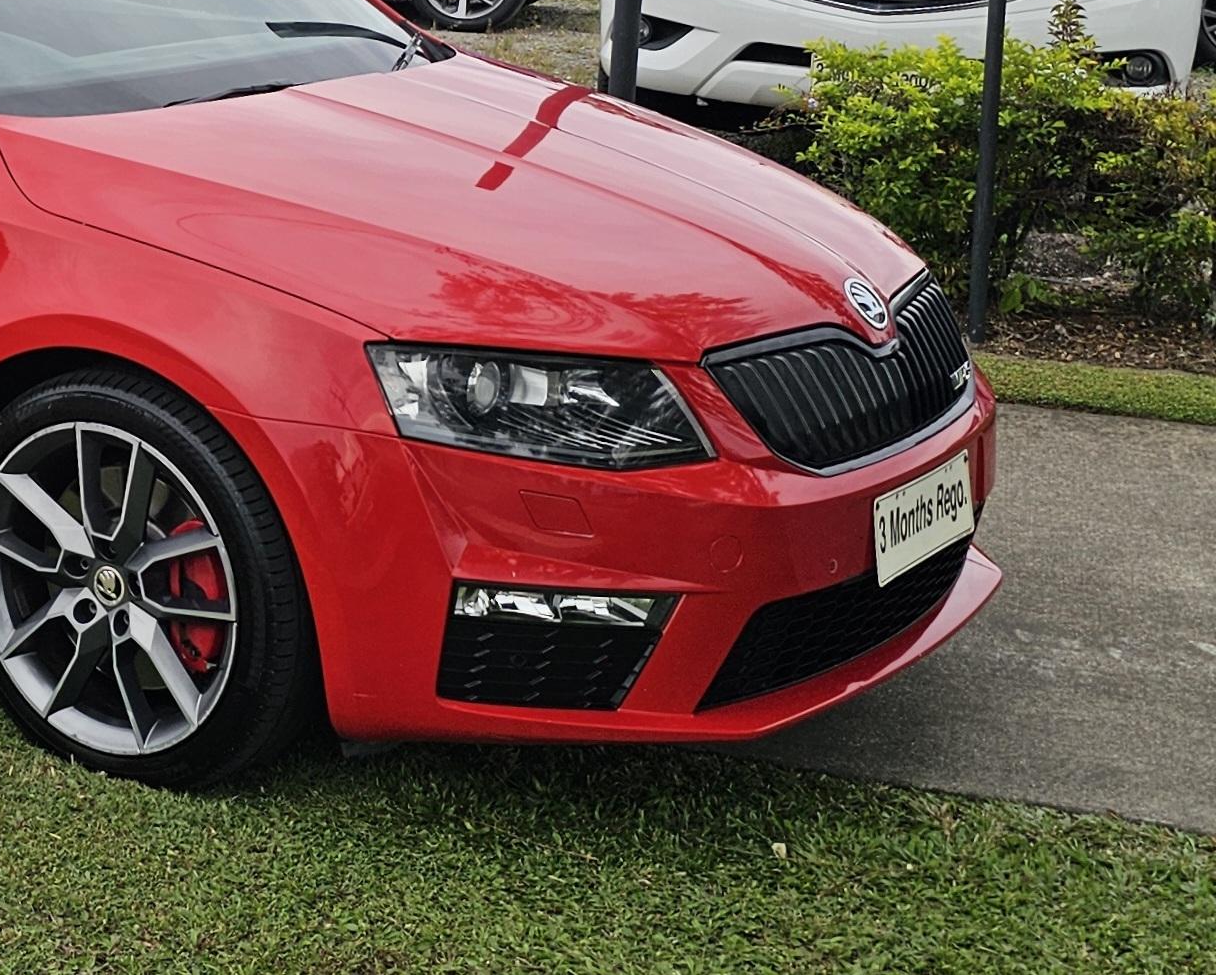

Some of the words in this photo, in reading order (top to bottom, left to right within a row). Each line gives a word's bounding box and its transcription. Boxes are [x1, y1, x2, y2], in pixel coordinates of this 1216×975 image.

[878, 516, 887, 554] 3
[889, 492, 934, 548] Months
[936, 478, 969, 523] Rego.
